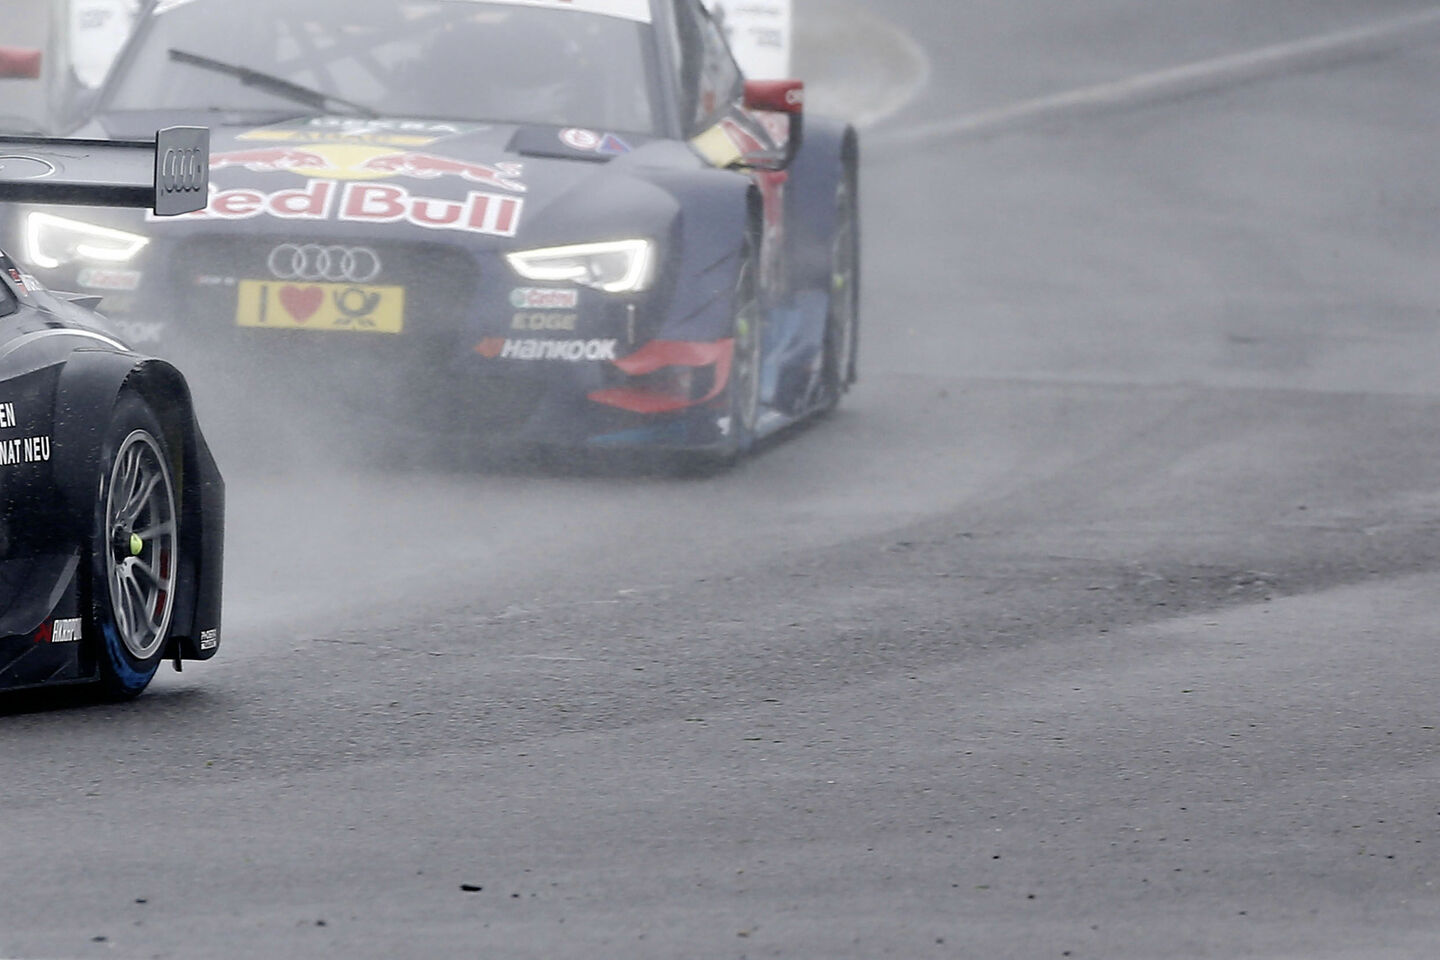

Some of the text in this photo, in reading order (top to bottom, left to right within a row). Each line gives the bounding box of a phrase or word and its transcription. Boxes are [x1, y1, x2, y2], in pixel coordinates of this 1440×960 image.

[150, 179, 526, 237] ed Bull
[24, 436, 50, 462] NEU
